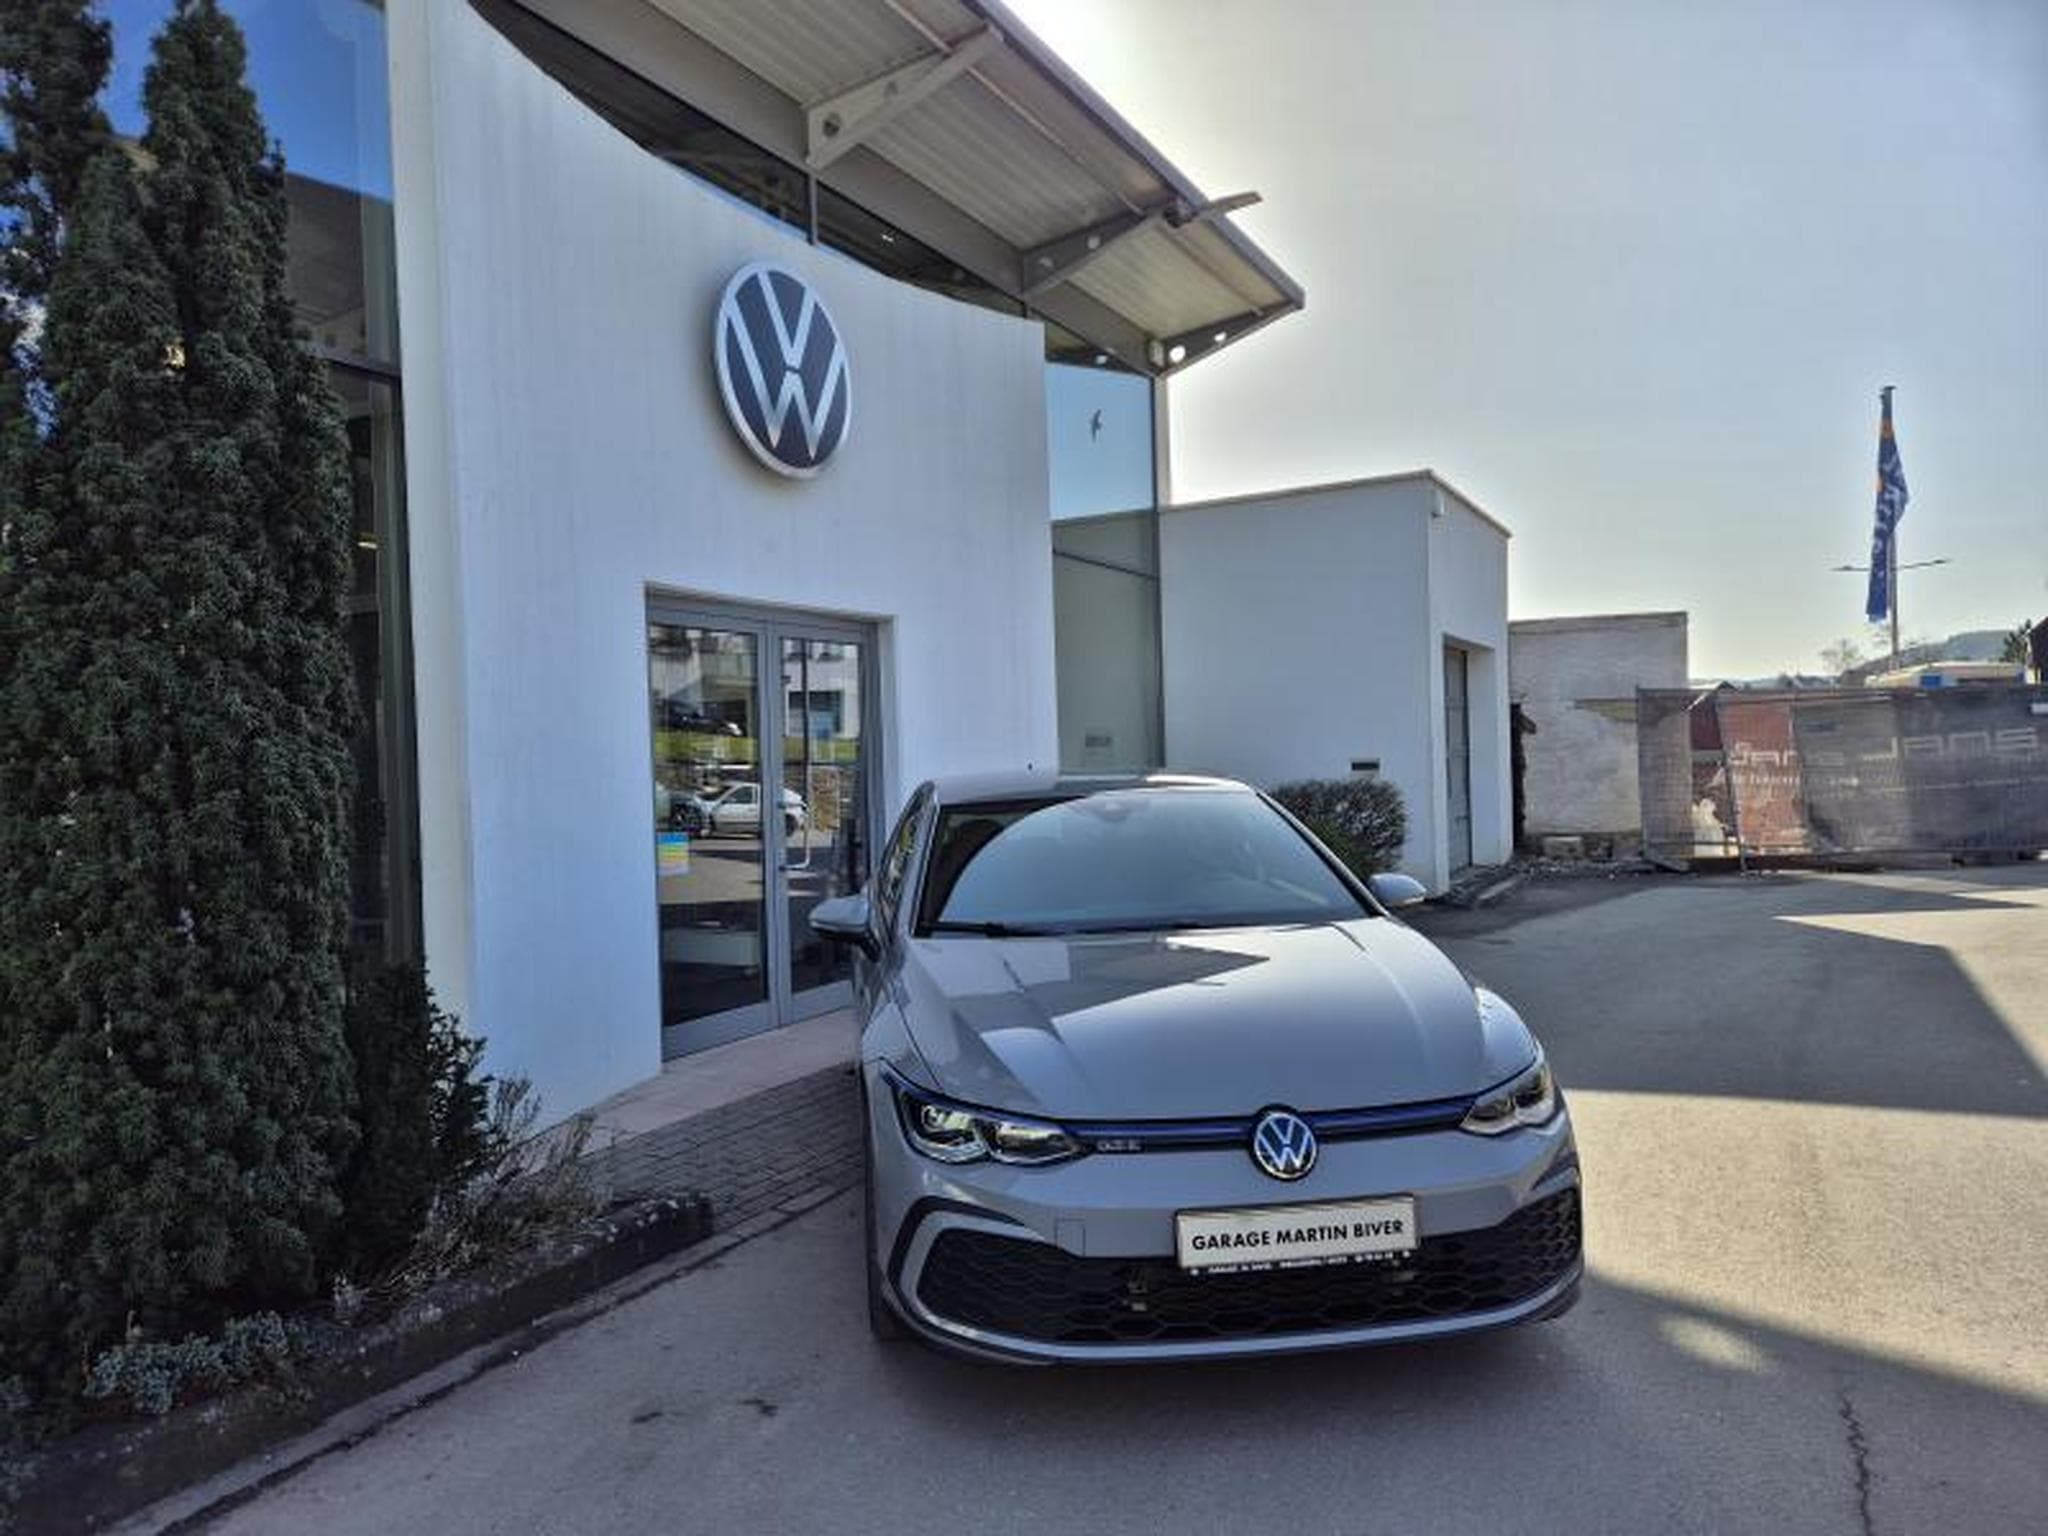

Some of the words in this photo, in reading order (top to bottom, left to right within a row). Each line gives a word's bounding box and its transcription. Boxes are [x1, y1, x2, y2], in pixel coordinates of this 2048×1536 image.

[719, 267, 848, 461] VW
[1257, 1116, 1313, 1171] VW
[1191, 1230, 1270, 1251] GARAGE
[1276, 1224, 1348, 1244] MARTIN
[1353, 1219, 1404, 1239] BIVER
